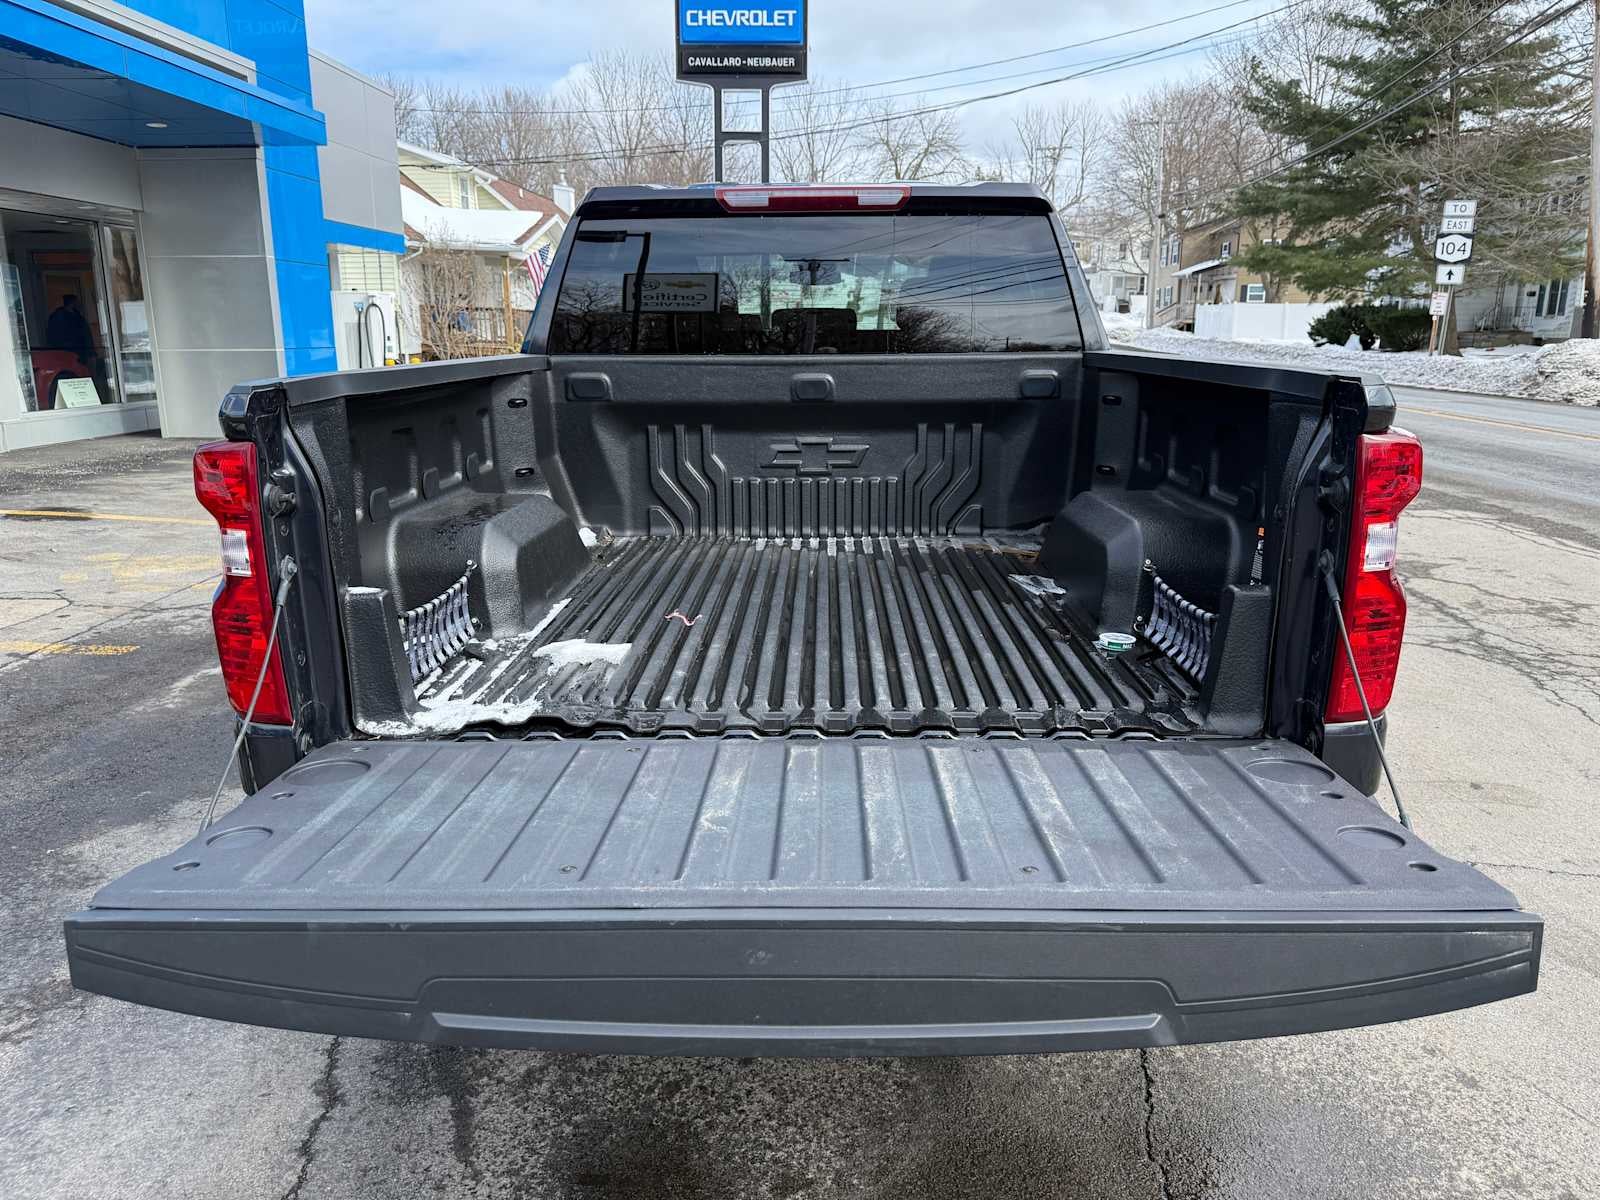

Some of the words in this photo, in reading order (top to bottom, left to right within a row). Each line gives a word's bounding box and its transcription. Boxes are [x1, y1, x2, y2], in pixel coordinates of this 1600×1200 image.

[686, 9, 797, 26] CHEVROLET
[688, 56, 796, 67] CAVALLARO-NEUBAUER
[1453, 204, 1467, 213] TO
[1447, 220, 1468, 230] EAST
[1440, 241, 1467, 256] 104
